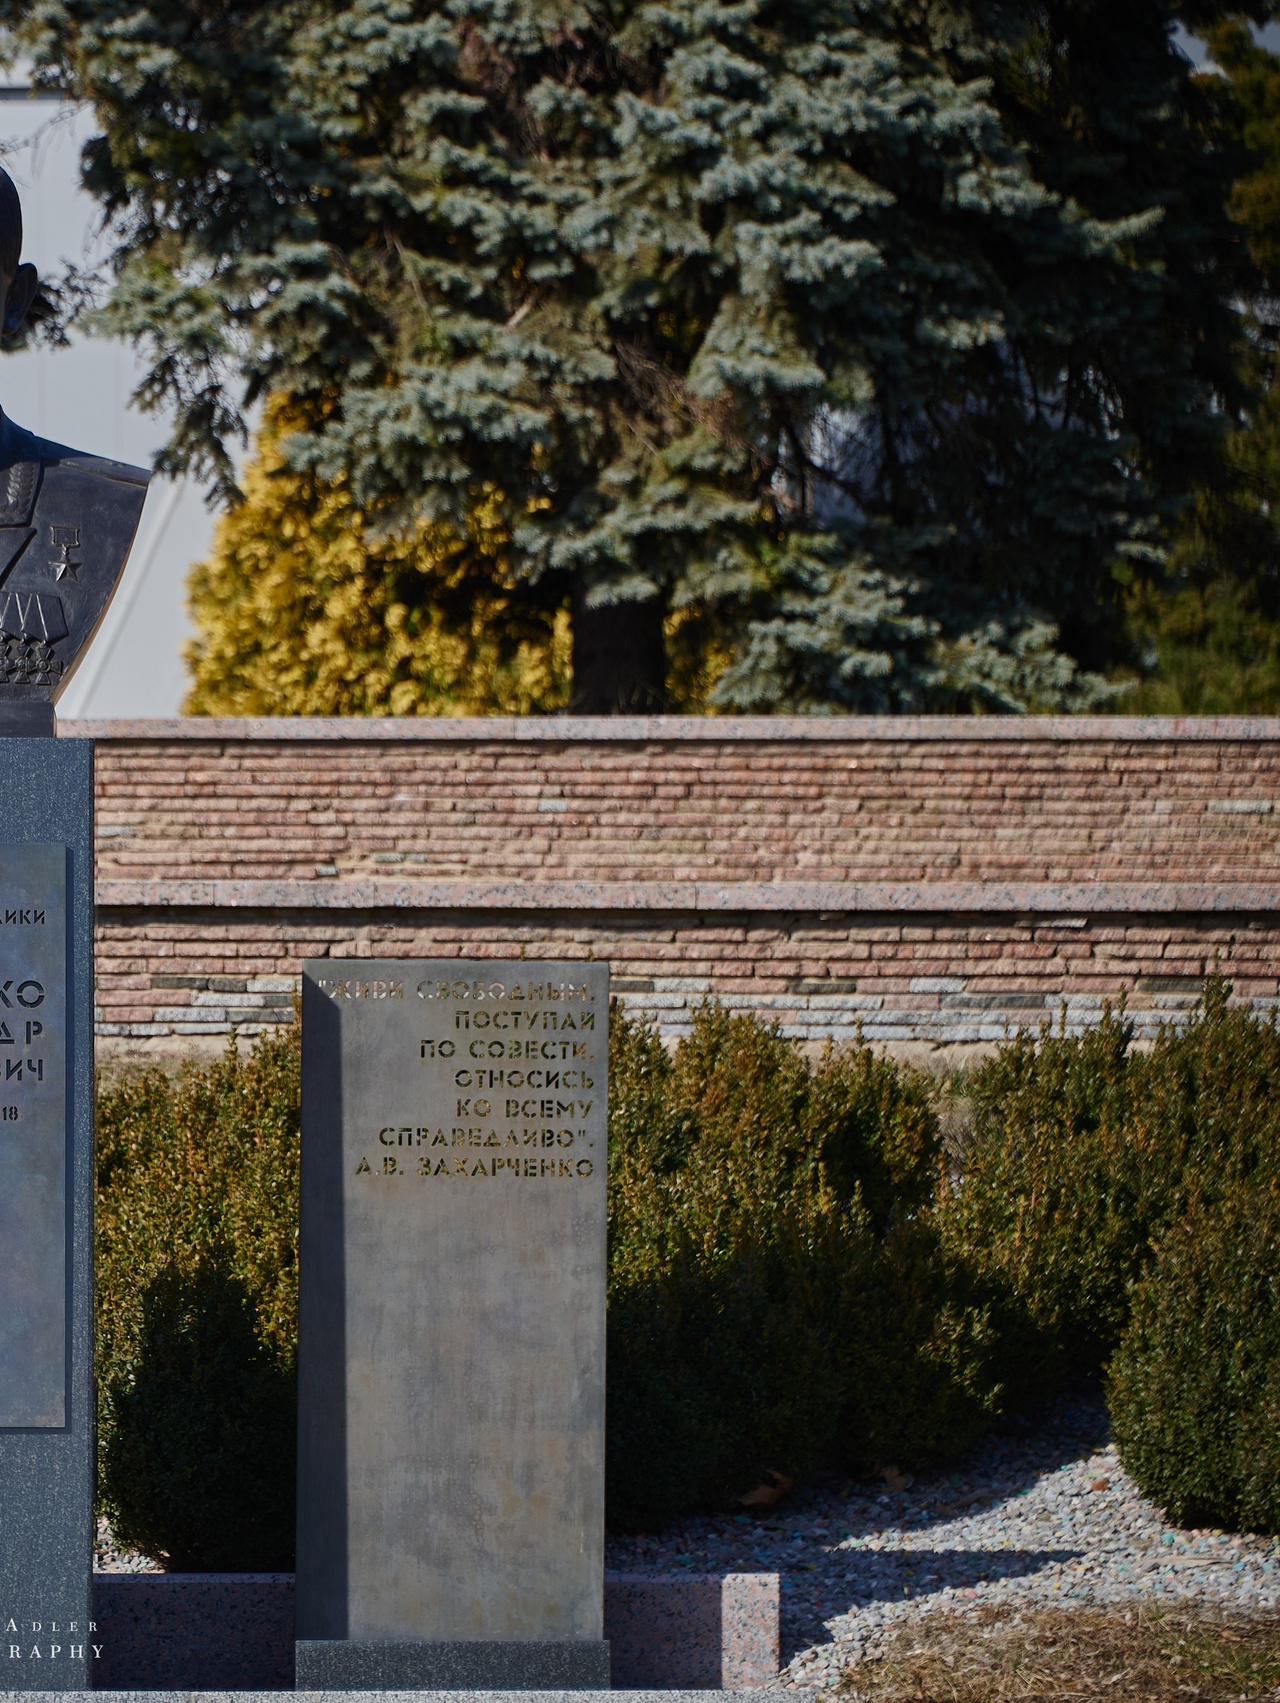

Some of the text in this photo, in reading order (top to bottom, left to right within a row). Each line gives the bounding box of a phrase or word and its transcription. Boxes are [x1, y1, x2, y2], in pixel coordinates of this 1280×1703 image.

[416, 980, 596, 1004] СВОБОДНЫМ,
[455, 1010, 596, 1031] ПОСТУПАЙ
[420, 1039, 596, 1063] ПО СОВЕСТИ,
[454, 1069, 595, 1090] ОТНОСИСЬ
[456, 1098, 594, 1119] КО ВСЕМУ
[354, 1156, 595, 1178] А.В. ЗАХАРЧЕНКО
